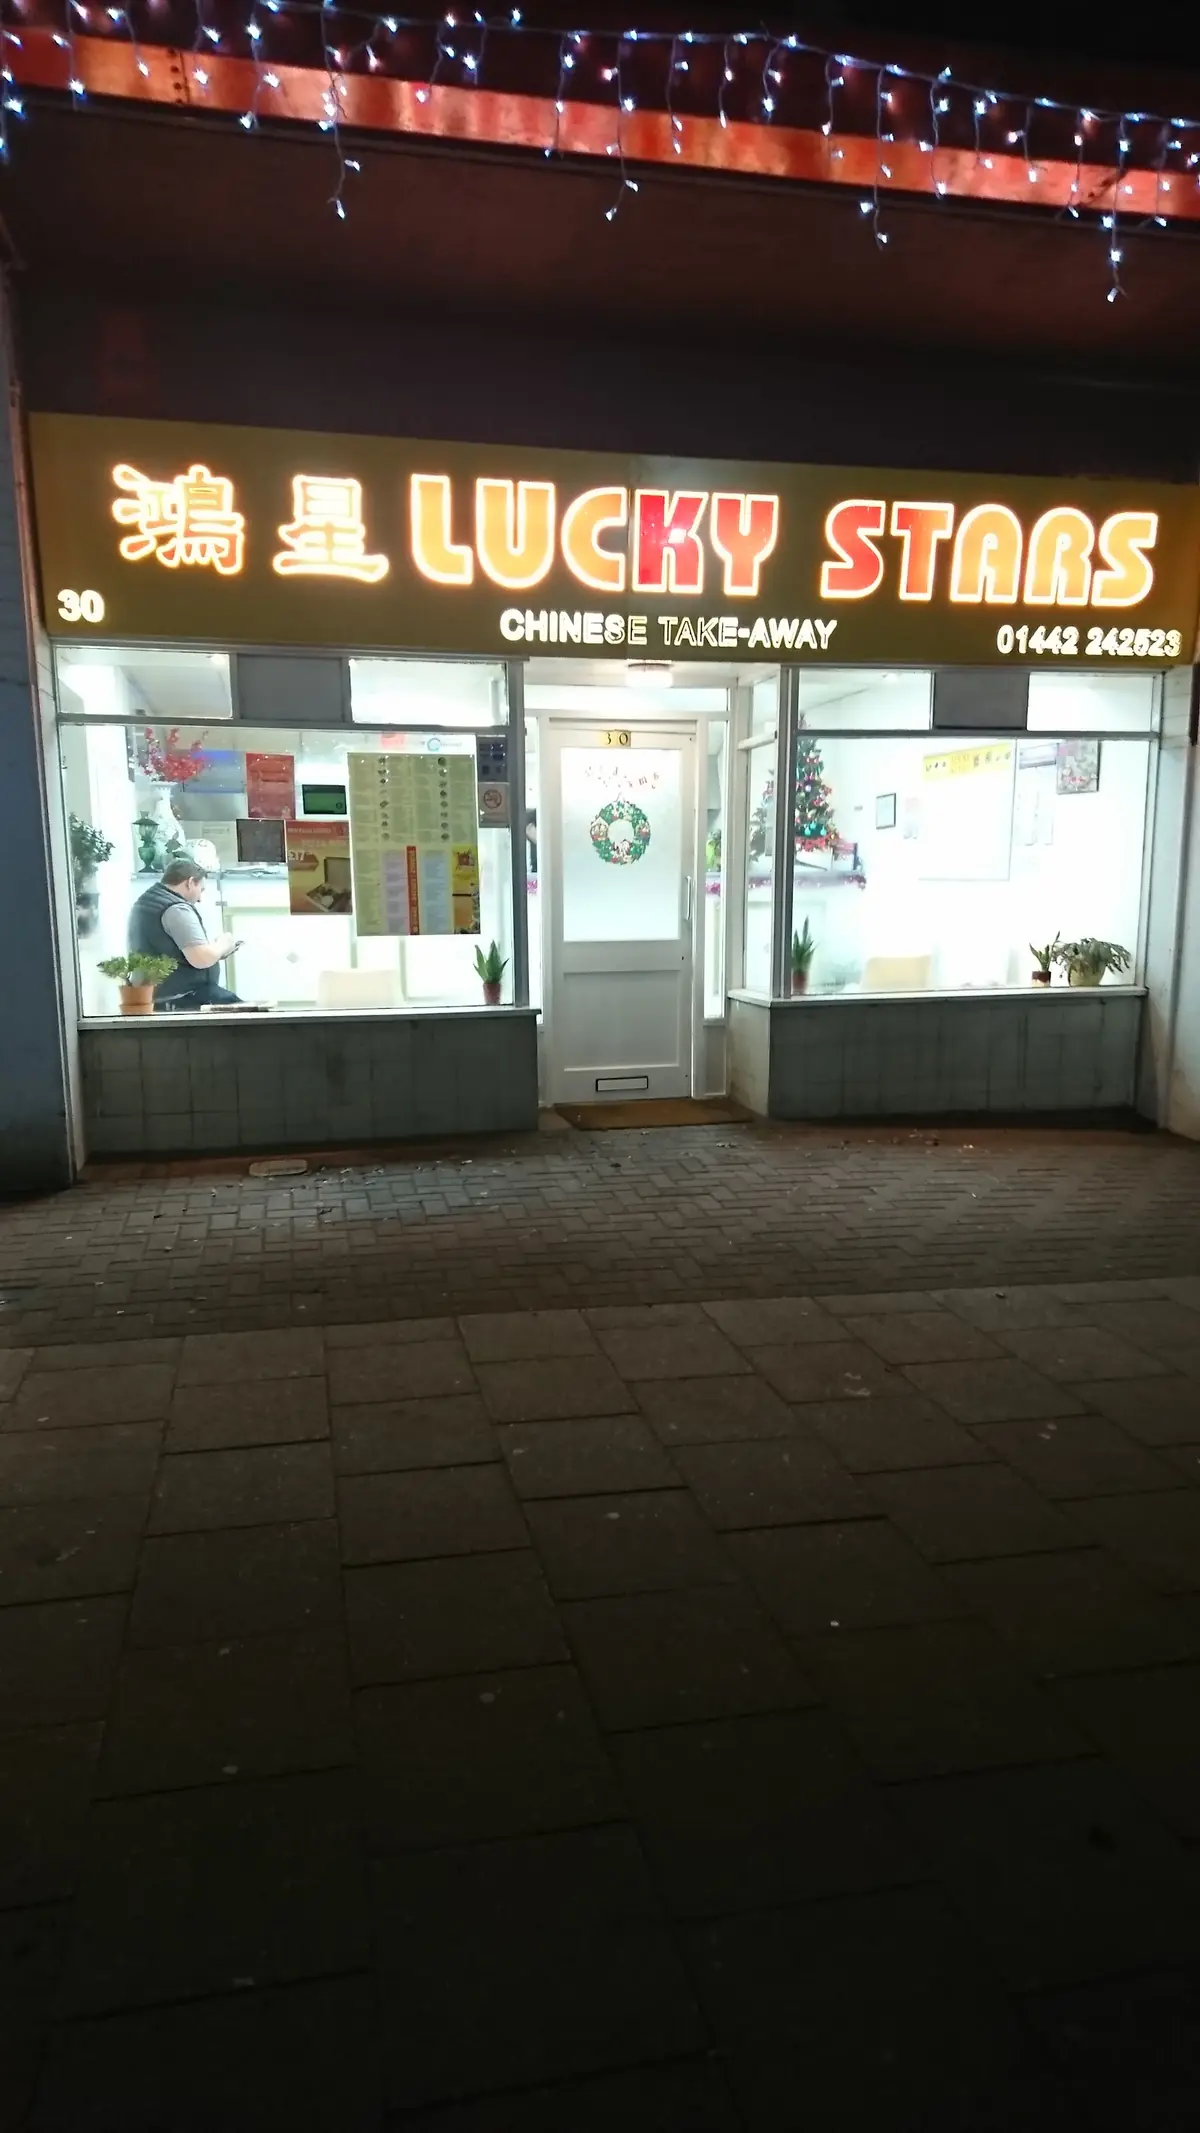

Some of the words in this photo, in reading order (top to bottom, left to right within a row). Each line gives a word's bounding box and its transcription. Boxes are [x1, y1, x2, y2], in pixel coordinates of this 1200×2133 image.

[409, 472, 780, 598] LUCKY
[819, 498, 1159, 607] STARS
[57, 588, 104, 622] 30
[499, 607, 648, 644] CHINESE
[657, 615, 838, 650] TAKE-AWAY
[996, 624, 1080, 655] 01442
[1085, 626, 1183, 657] 242523
[606, 731, 629, 746] 30
